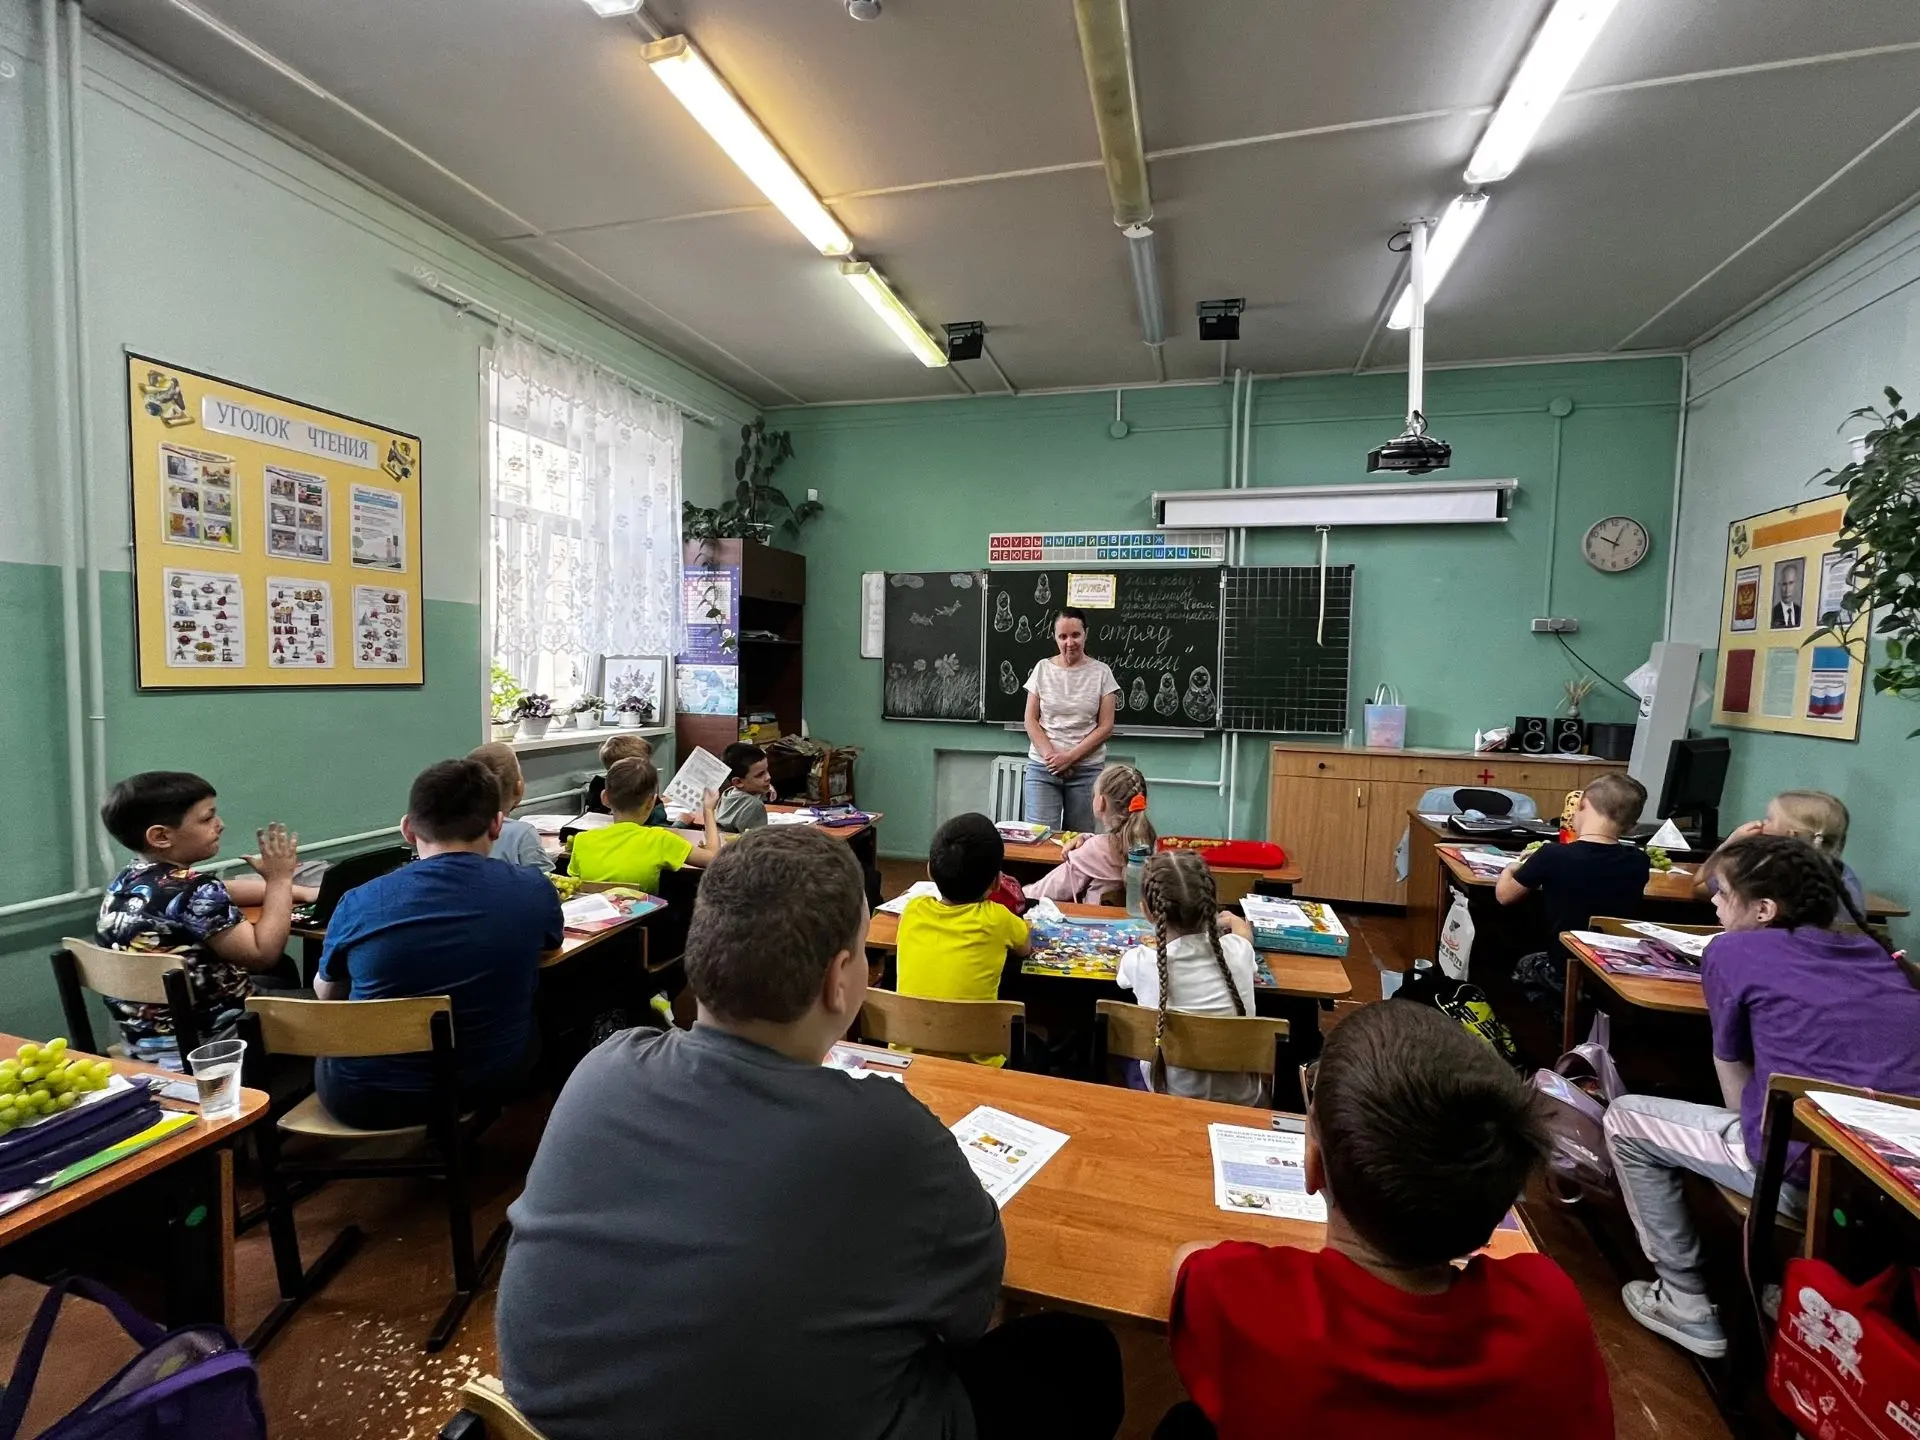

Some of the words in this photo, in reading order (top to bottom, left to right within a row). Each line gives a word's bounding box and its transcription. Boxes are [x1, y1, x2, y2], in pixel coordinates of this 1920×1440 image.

[216, 402, 290, 440] УГОЛОК
[308, 426, 369, 460] ЧТЕНИЯ
[1100, 624, 1173, 654] отряд
